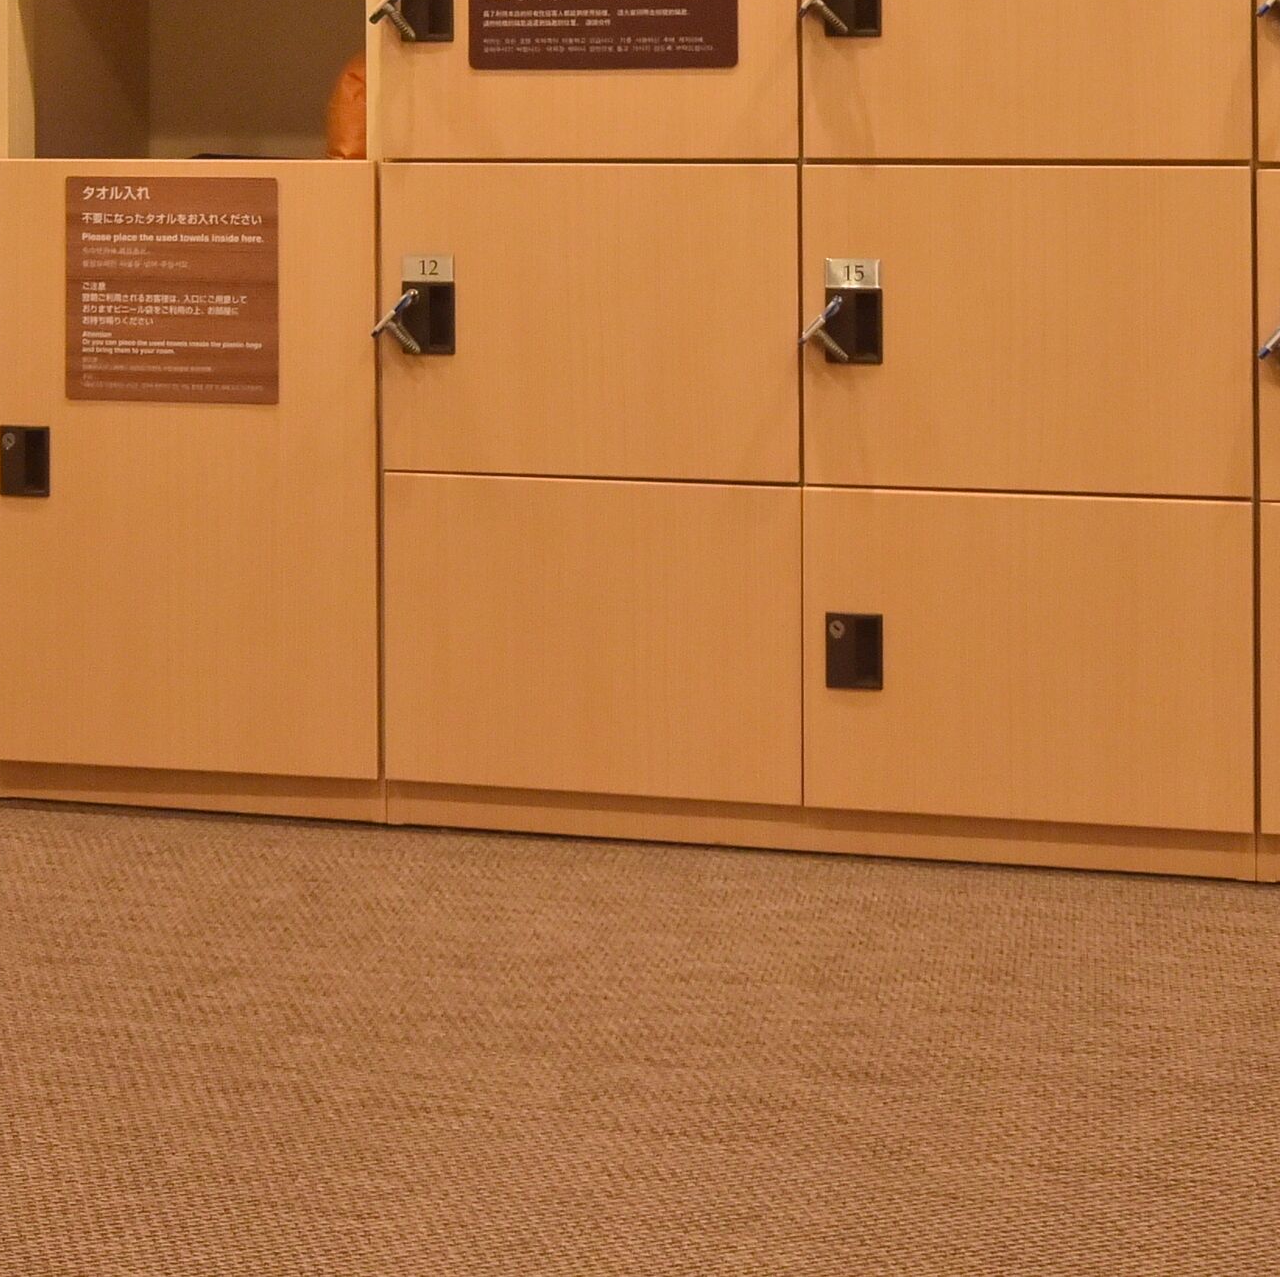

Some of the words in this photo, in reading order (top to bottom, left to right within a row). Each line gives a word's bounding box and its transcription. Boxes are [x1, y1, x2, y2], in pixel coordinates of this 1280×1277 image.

[82, 185, 150, 200] タオル入れ
[81, 213, 262, 225] 不要になったタオルをお入れください
[82, 232, 111, 241] Please
[113, 233, 138, 242] place
[140, 233, 154, 242] the
[156, 233, 178, 242] used
[180, 234, 209, 242] towels
[211, 234, 239, 243] inside
[241, 234, 264, 243] here.
[419, 260, 439, 276] 12
[844, 265, 864, 281] 15
